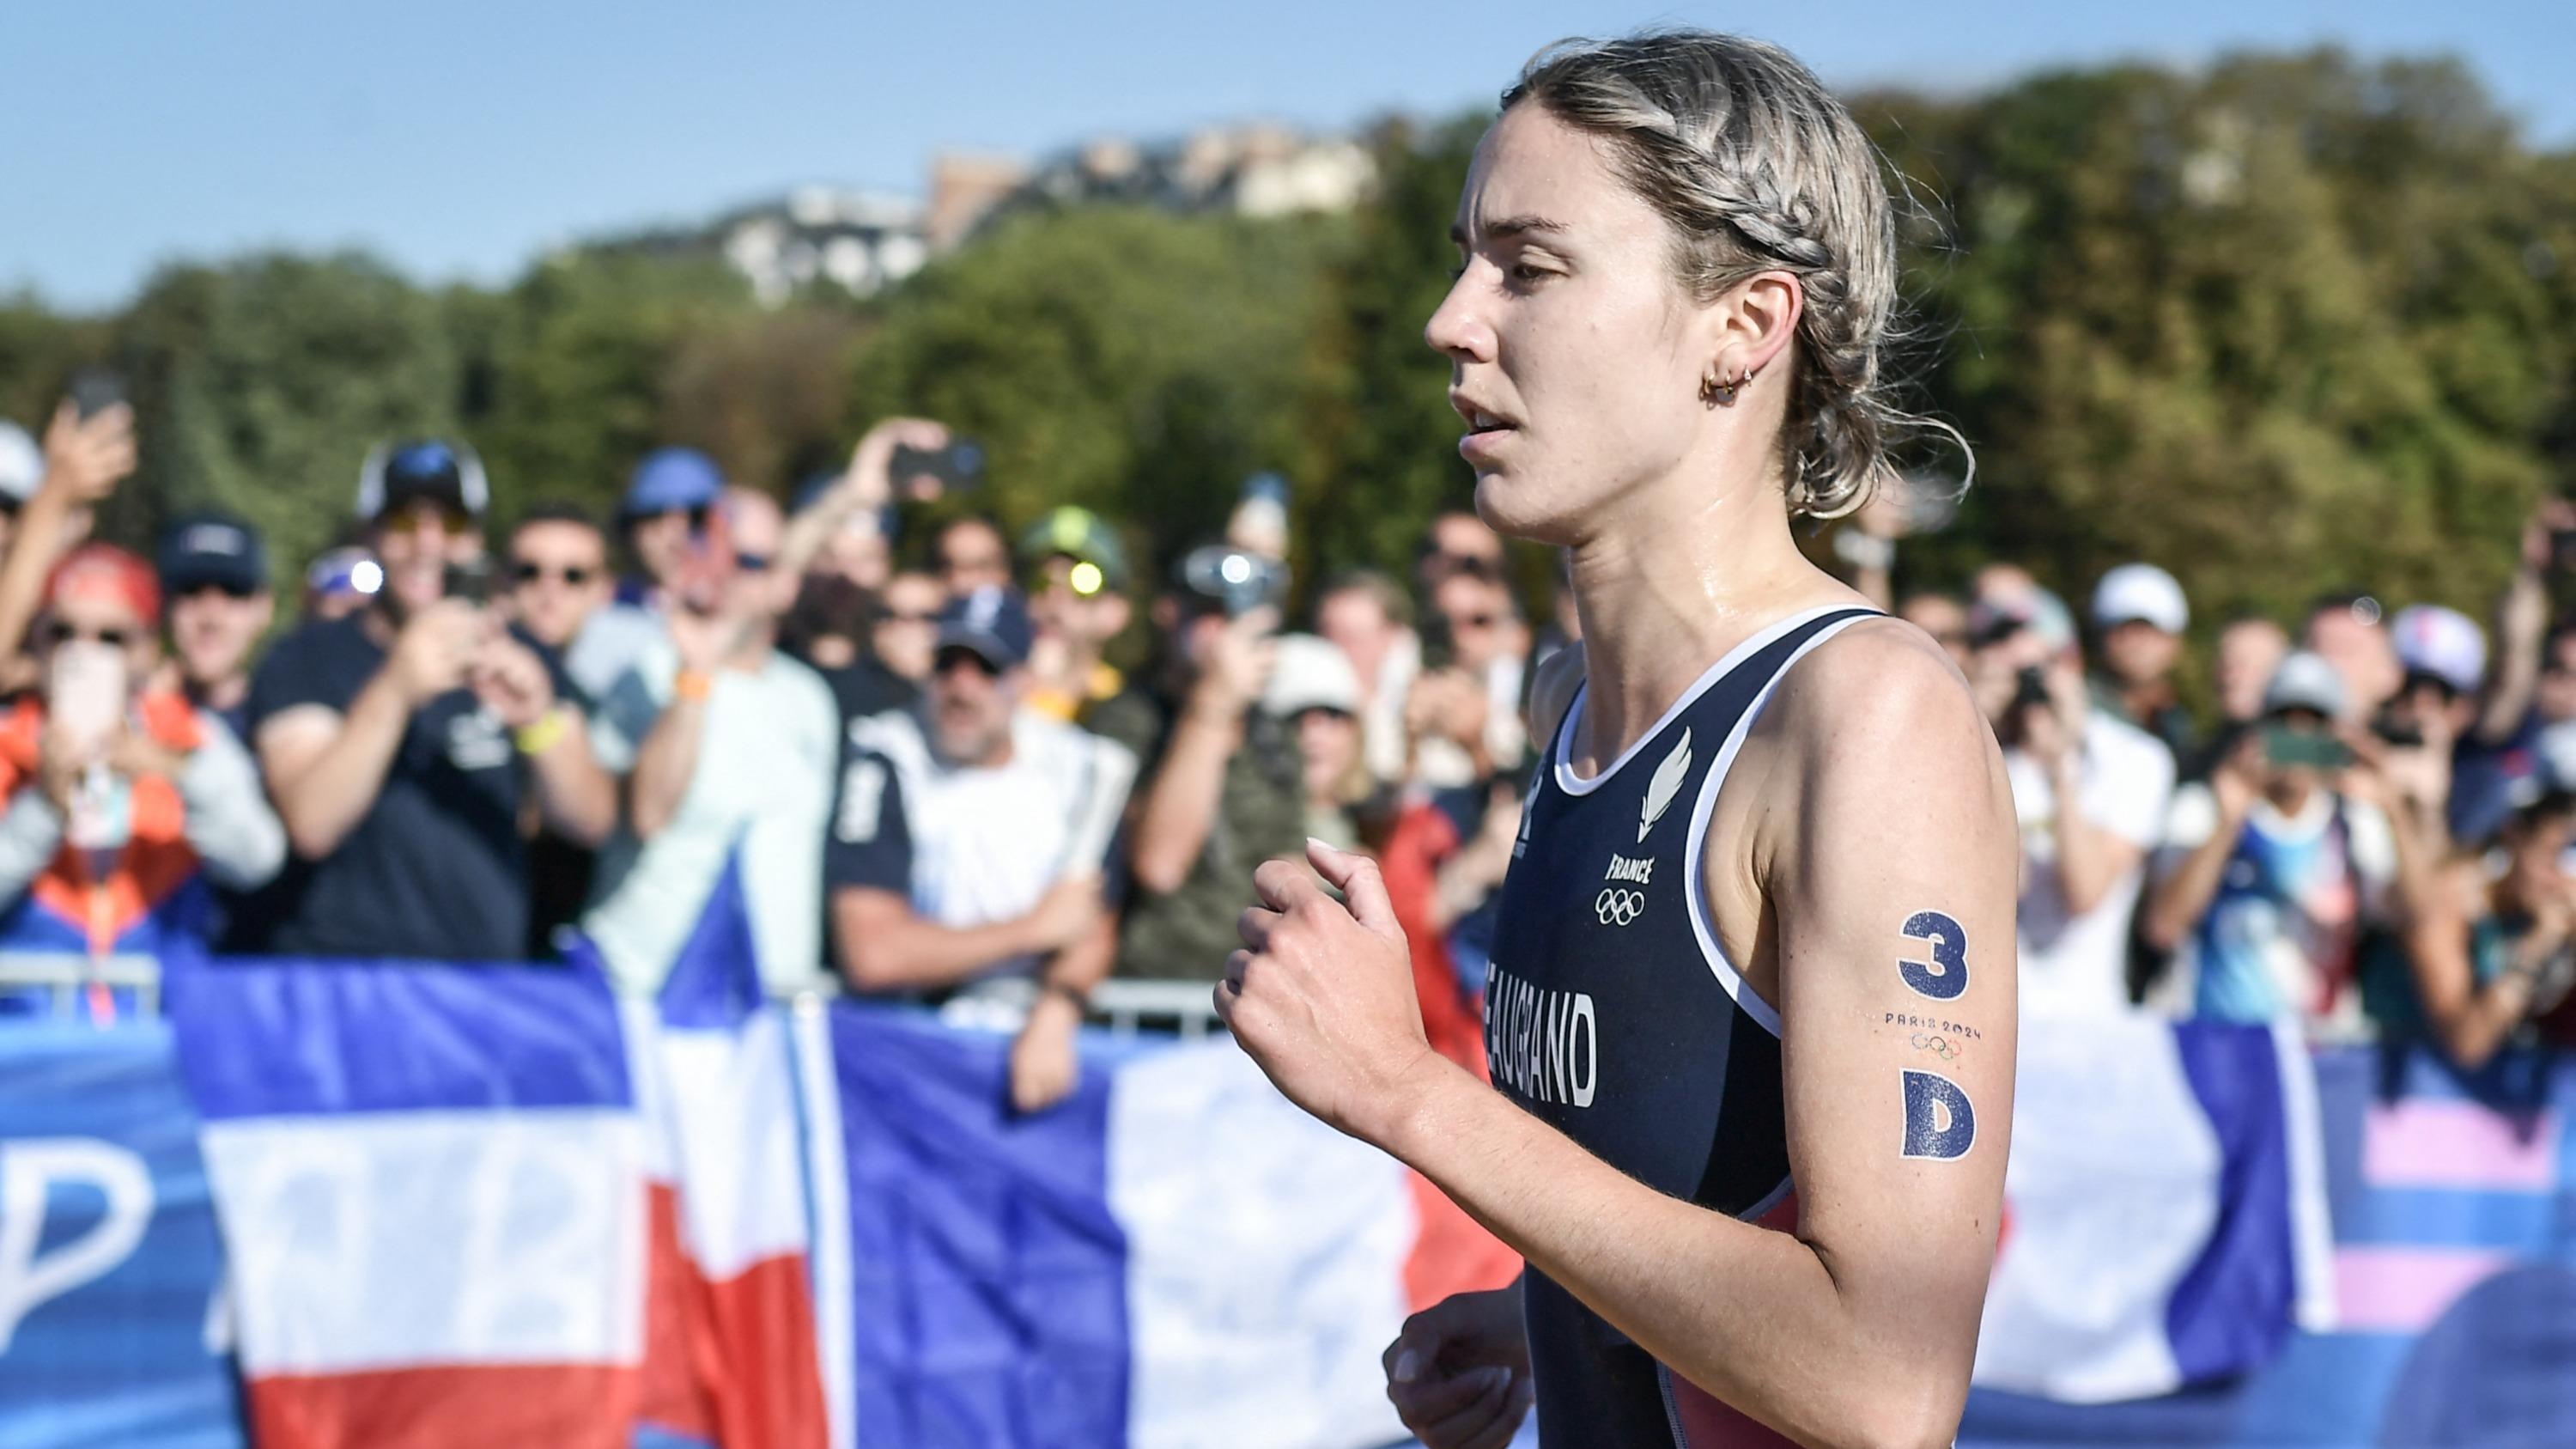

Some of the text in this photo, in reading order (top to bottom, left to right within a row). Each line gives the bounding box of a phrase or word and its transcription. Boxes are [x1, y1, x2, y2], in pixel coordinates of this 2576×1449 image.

[1605, 852, 1656, 885] FRANCE
[1895, 907, 1971, 1003] 3
[1885, 1013, 1982, 1040] PARIS 2024
[1899, 1067, 1978, 1162] D
